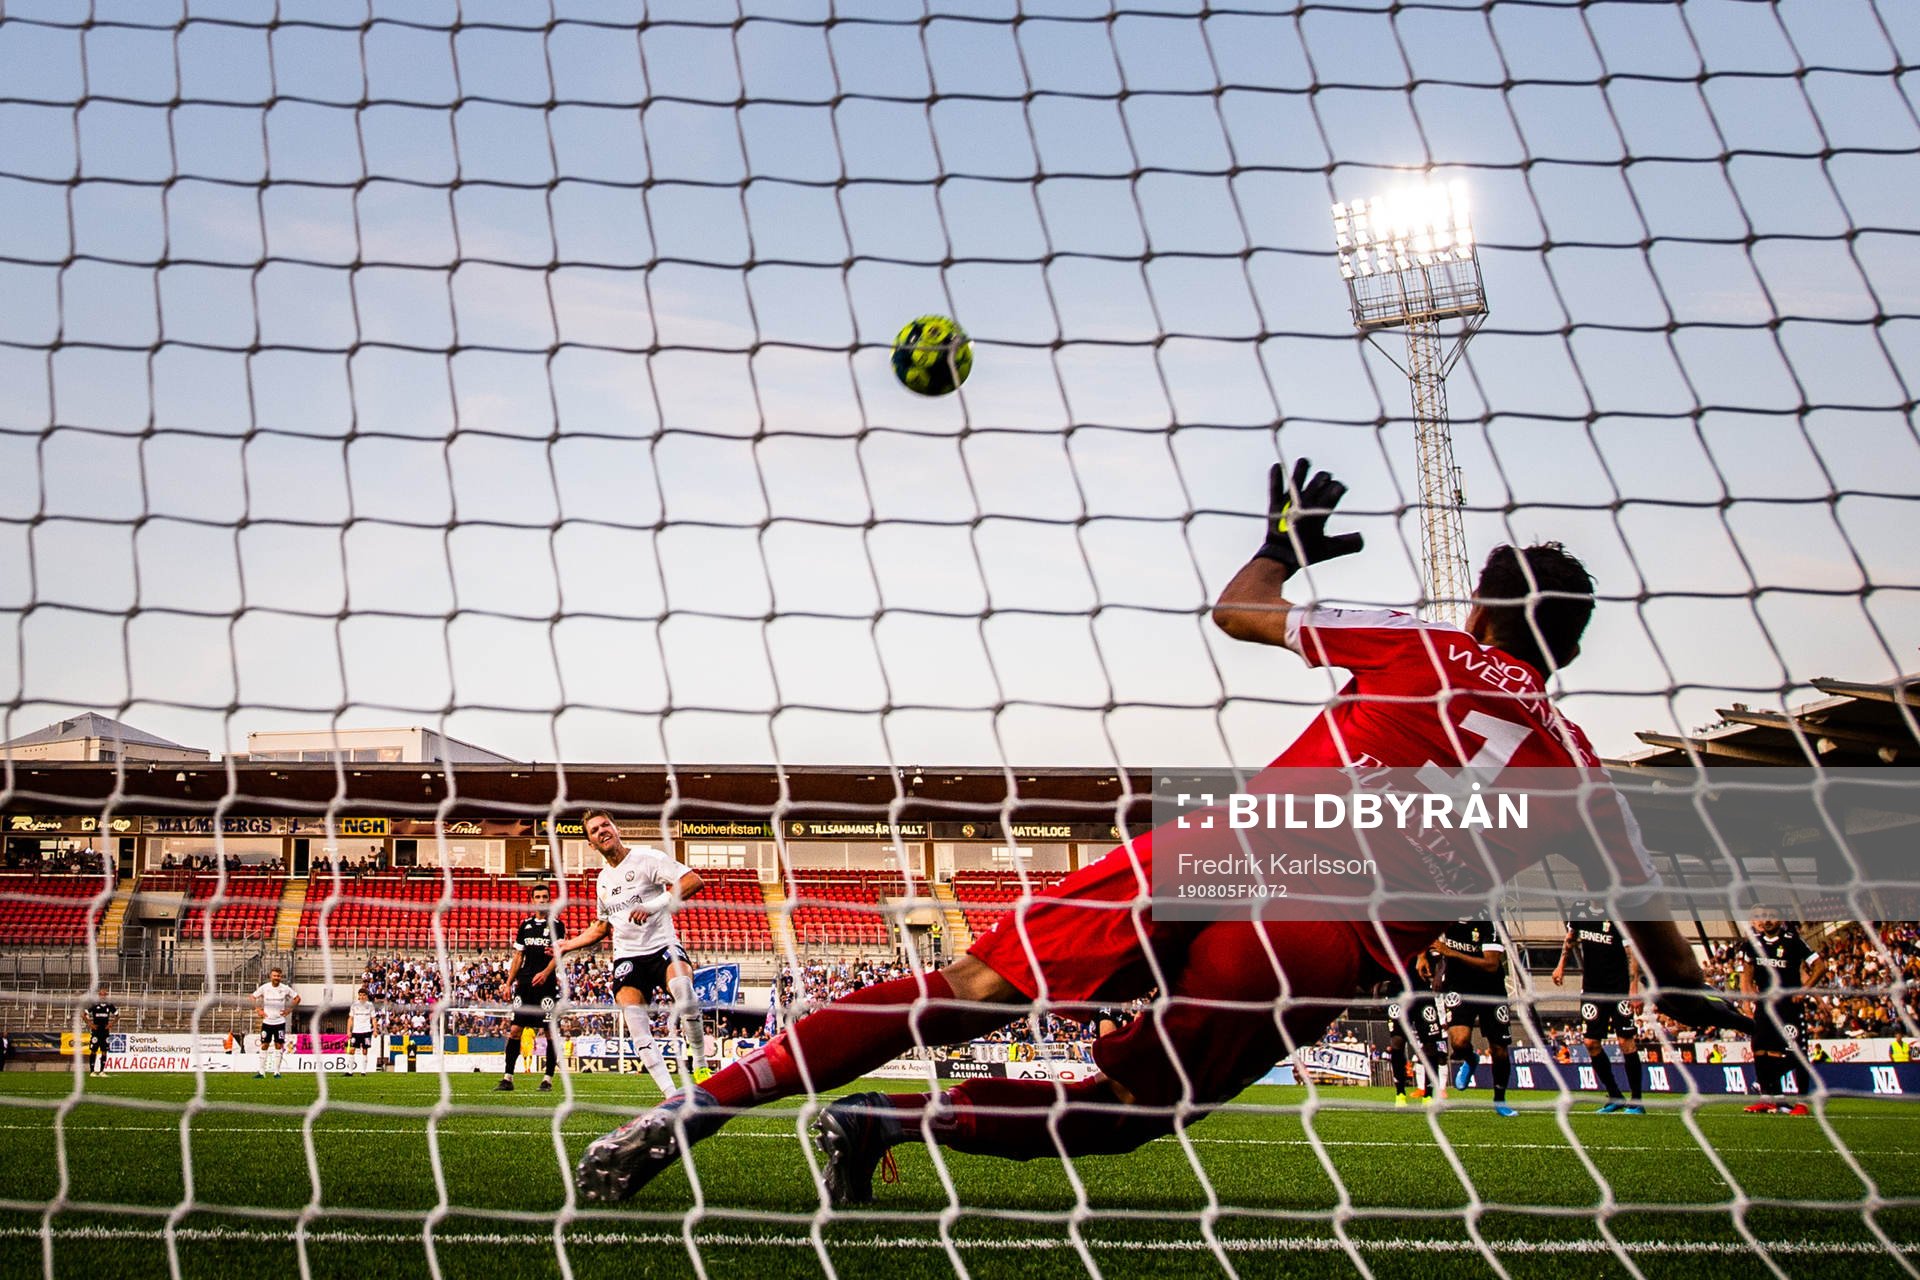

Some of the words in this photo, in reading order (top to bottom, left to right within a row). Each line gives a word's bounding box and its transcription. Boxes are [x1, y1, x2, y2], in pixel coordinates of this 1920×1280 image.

[157, 818, 272, 833] MALMERGS
[442, 821, 482, 835] Linde
[683, 823, 761, 835] Mobilverkstan
[809, 824, 874, 834] TILLSAMMANS
[901, 825, 926, 835] ALLT.
[1009, 826, 1071, 837] MATCHLOGE
[129, 1035, 158, 1044] Svensk
[129, 1045, 191, 1054] Kvalitetssäkring
[582, 1059, 677, 1073] XL-BYG
[952, 1062, 989, 1071] ÖREBRO
